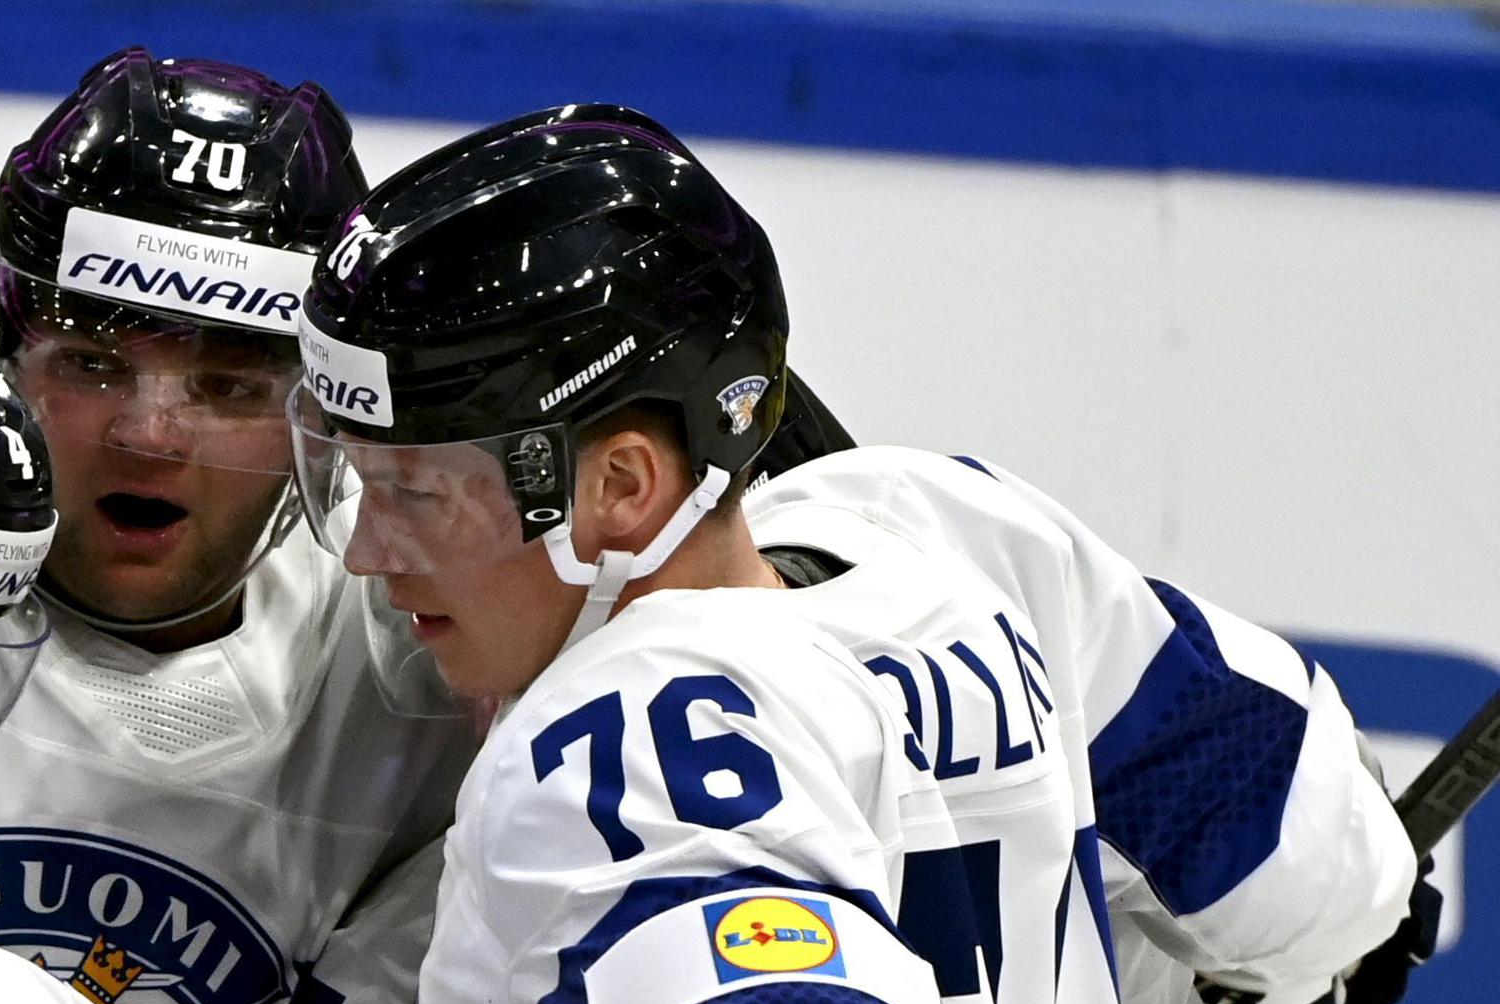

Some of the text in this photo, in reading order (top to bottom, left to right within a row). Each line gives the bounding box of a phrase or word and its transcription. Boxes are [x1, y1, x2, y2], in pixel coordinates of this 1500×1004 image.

[171, 129, 248, 191] 70
[136, 233, 249, 271] FLYING WITH
[327, 213, 381, 281] 76
[67, 252, 301, 322] FINNAIR
[303, 359, 380, 415] NAIR
[538, 334, 638, 413] WARRIOR
[728, 381, 763, 399] SUOMI
[0, 425, 34, 480] 4
[530, 674, 784, 863] 76
